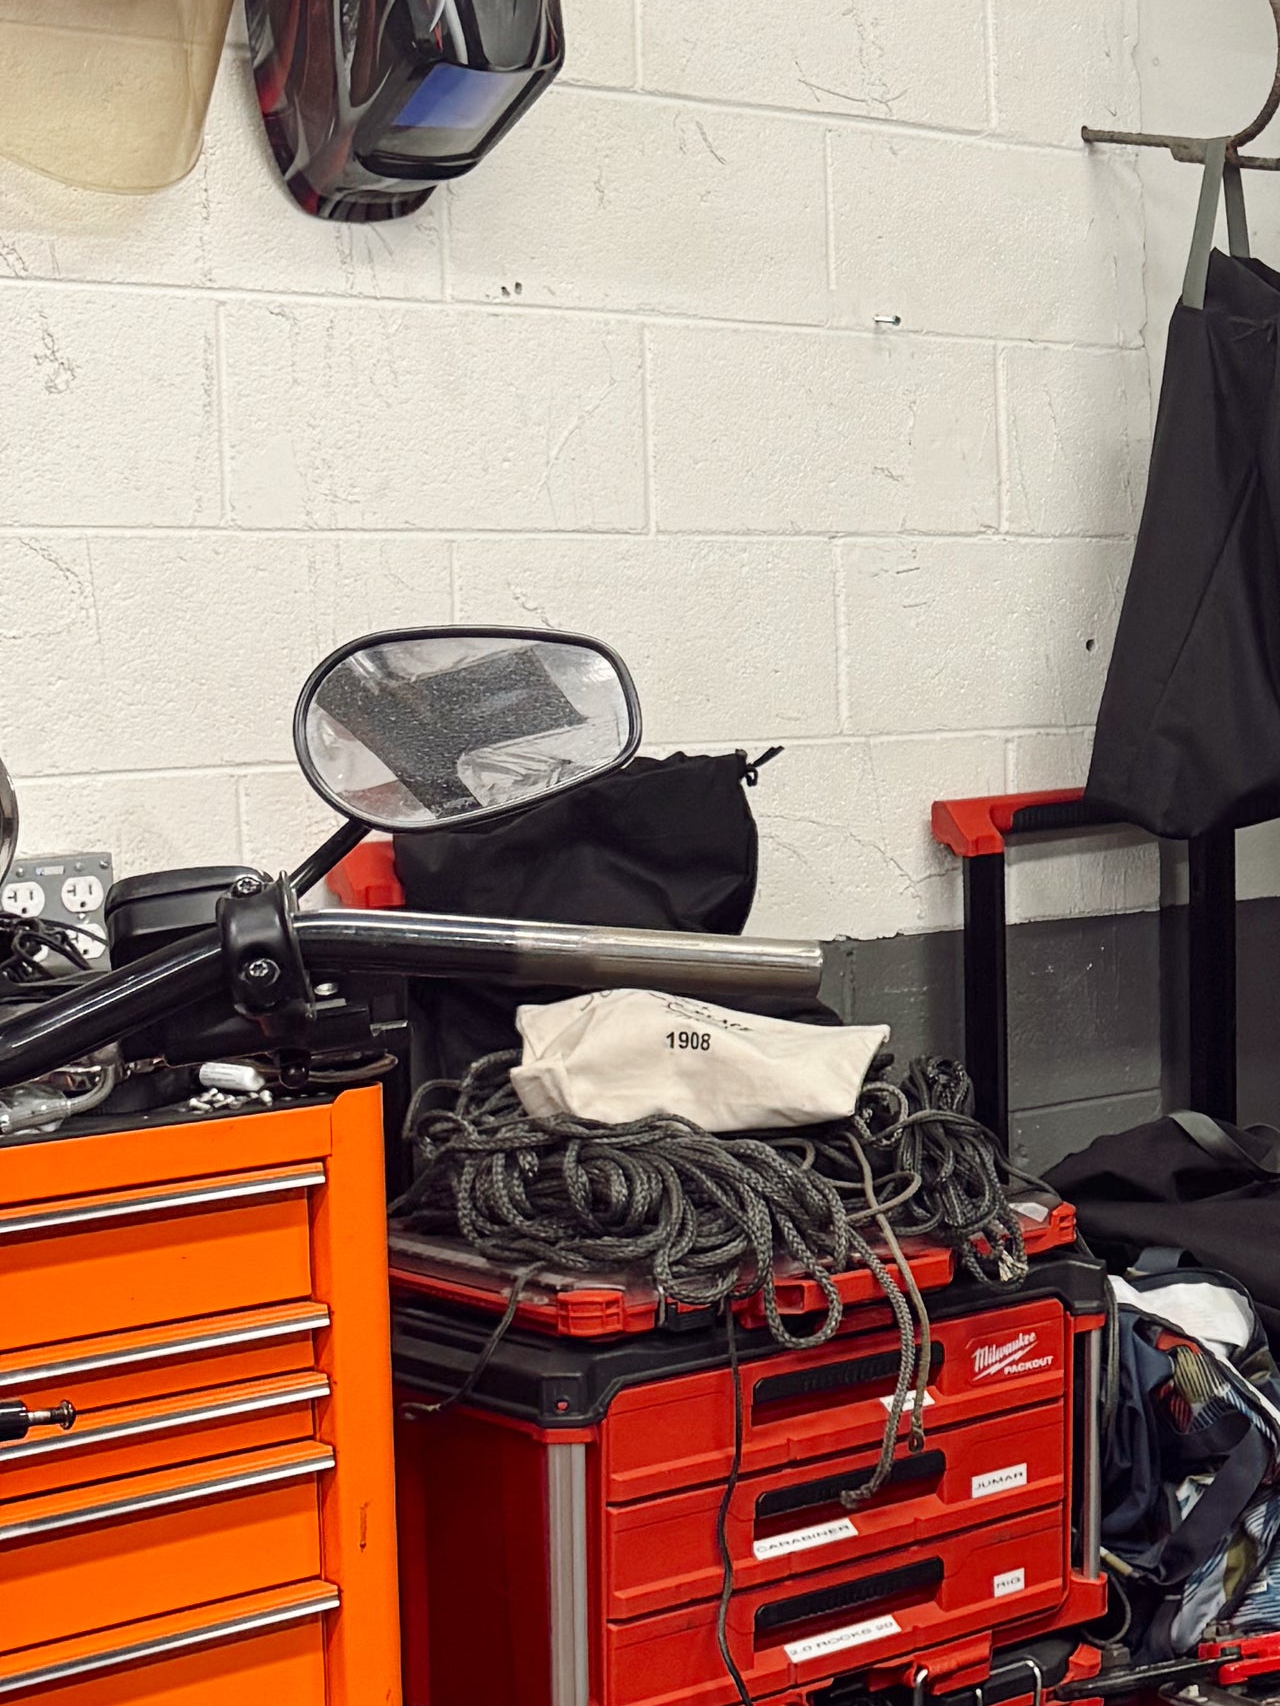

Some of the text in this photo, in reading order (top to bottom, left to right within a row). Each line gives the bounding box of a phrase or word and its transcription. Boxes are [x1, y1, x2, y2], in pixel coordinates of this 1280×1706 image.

[665, 1031, 711, 1052] 1908
[972, 1331, 1037, 1372] Milwaukee
[1004, 1355, 1054, 1375] PACKOUT
[974, 1471, 1024, 1490] JUMAR
[756, 1524, 850, 1553] CARABINER
[996, 1576, 1022, 1589] RIG
